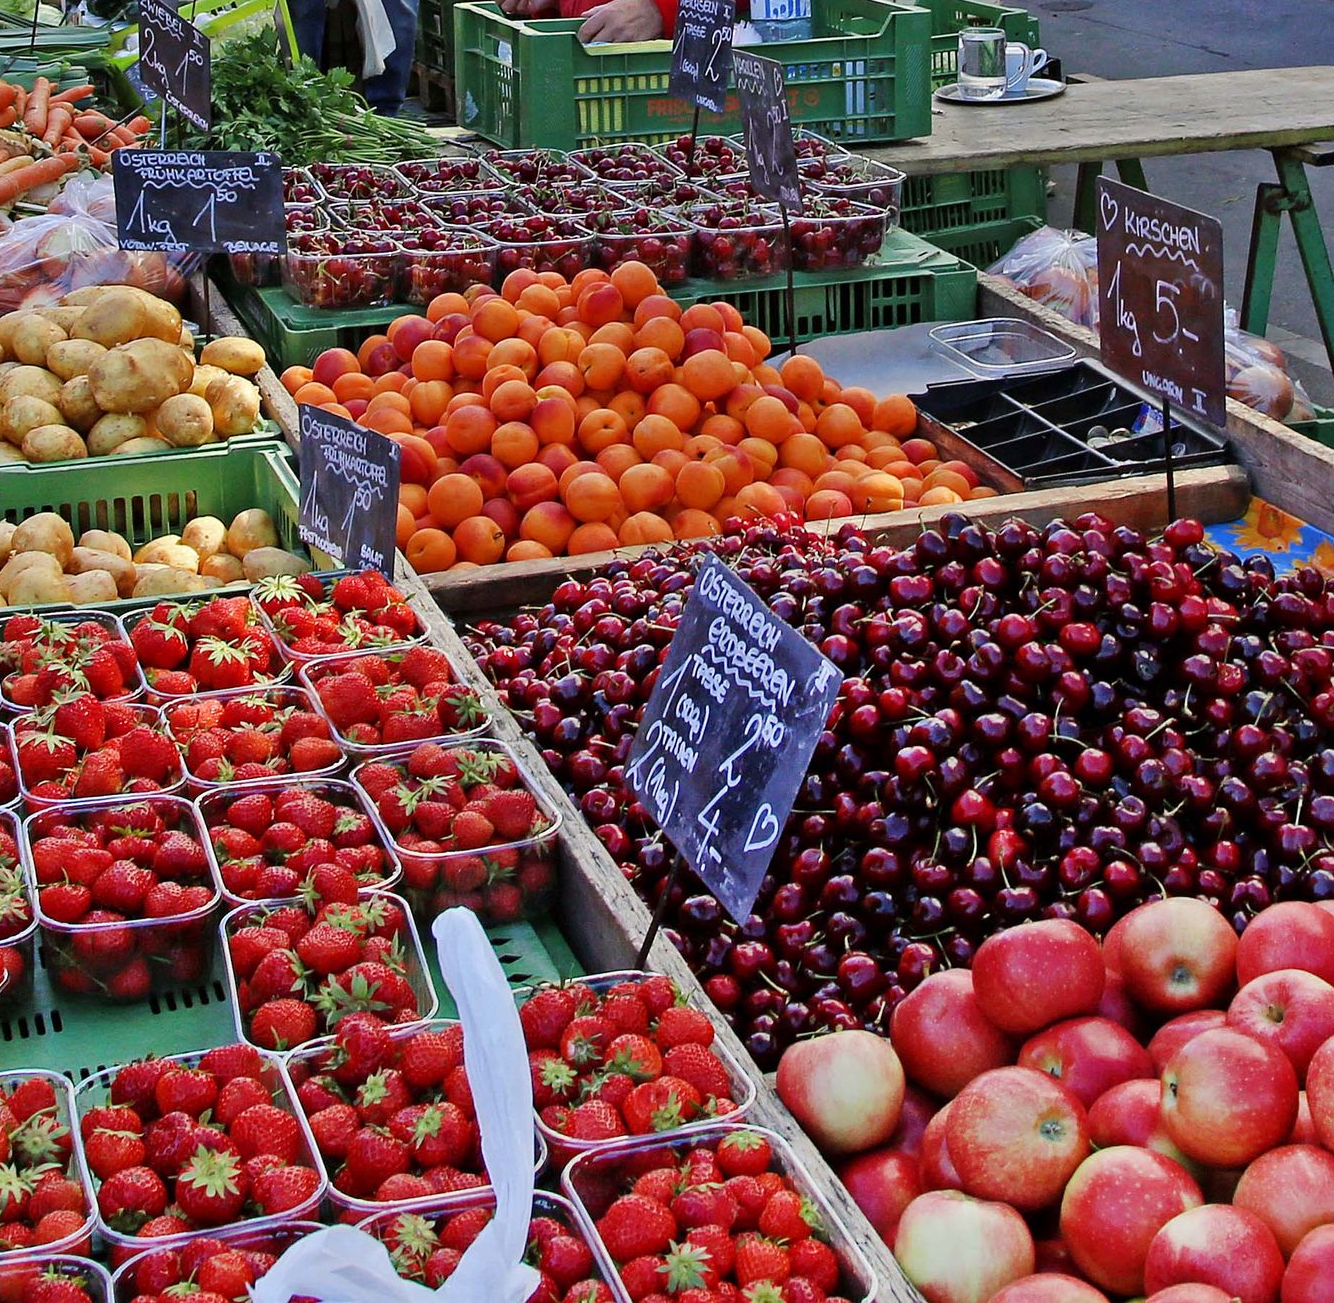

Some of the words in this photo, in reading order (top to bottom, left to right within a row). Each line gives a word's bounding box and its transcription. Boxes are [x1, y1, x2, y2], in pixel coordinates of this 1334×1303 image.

[685, 23, 708, 38] TASSE
[135, 167, 260, 182] FRÜHKARTOFFEL
[1125, 207, 1201, 255] KIRSCHEN
[691, 654, 731, 704] TASSE
[708, 616, 798, 708] ERDBEEREN
